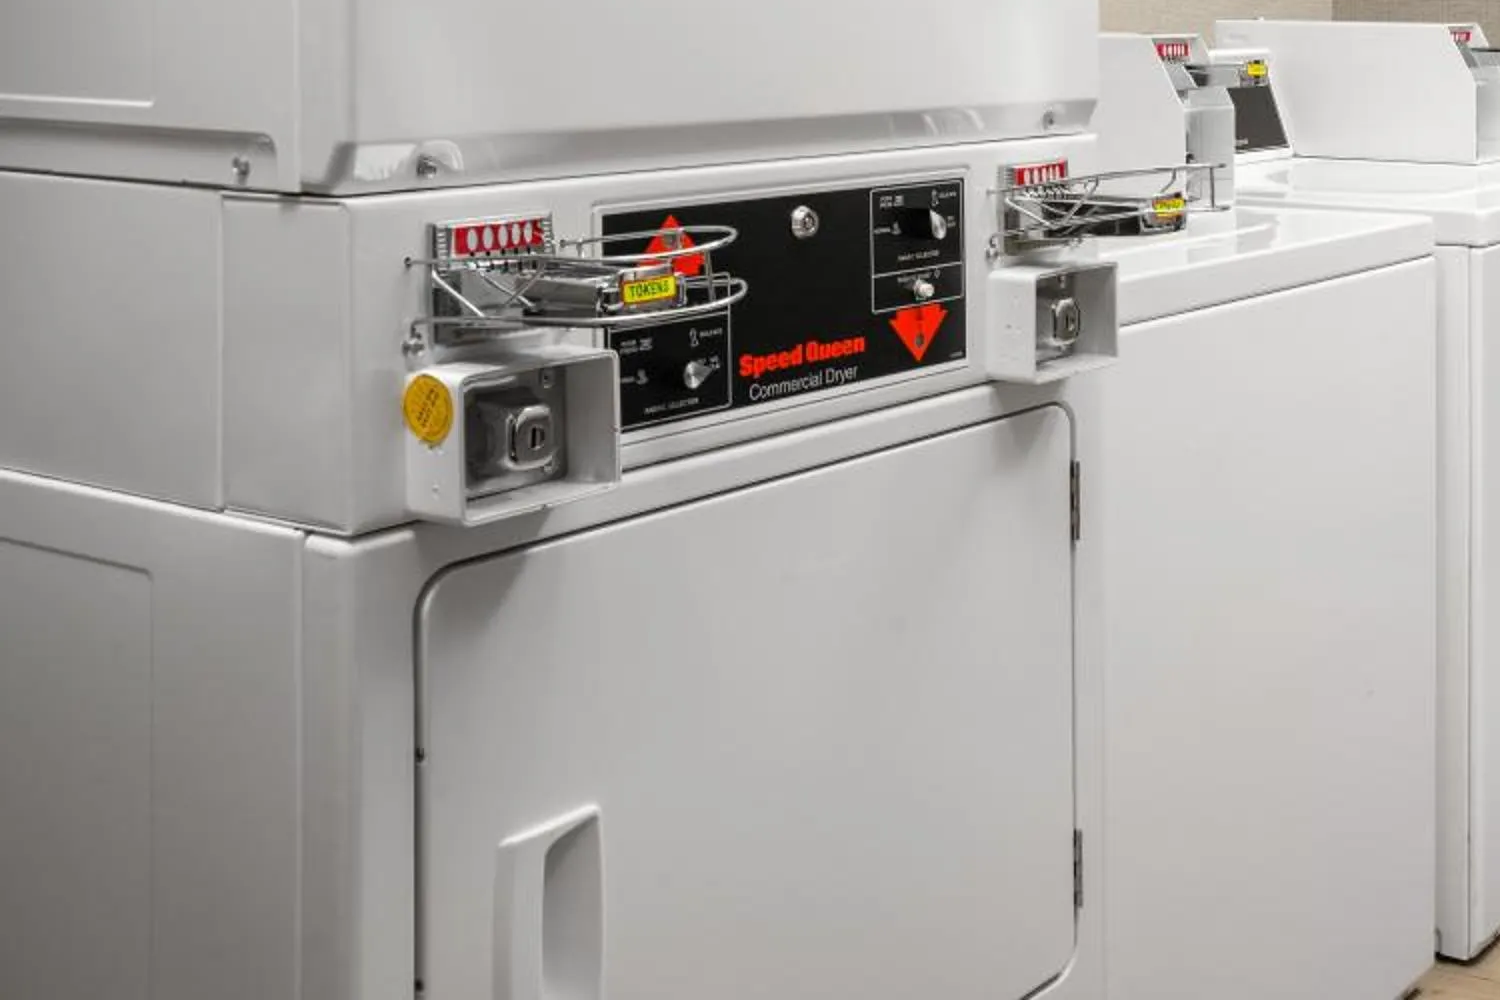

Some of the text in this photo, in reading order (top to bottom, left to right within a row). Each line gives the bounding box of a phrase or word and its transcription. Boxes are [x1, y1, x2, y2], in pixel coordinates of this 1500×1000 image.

[739, 343, 803, 377] Speed
[806, 336, 866, 362] Queen
[749, 365, 858, 401] Commercial Dryer
